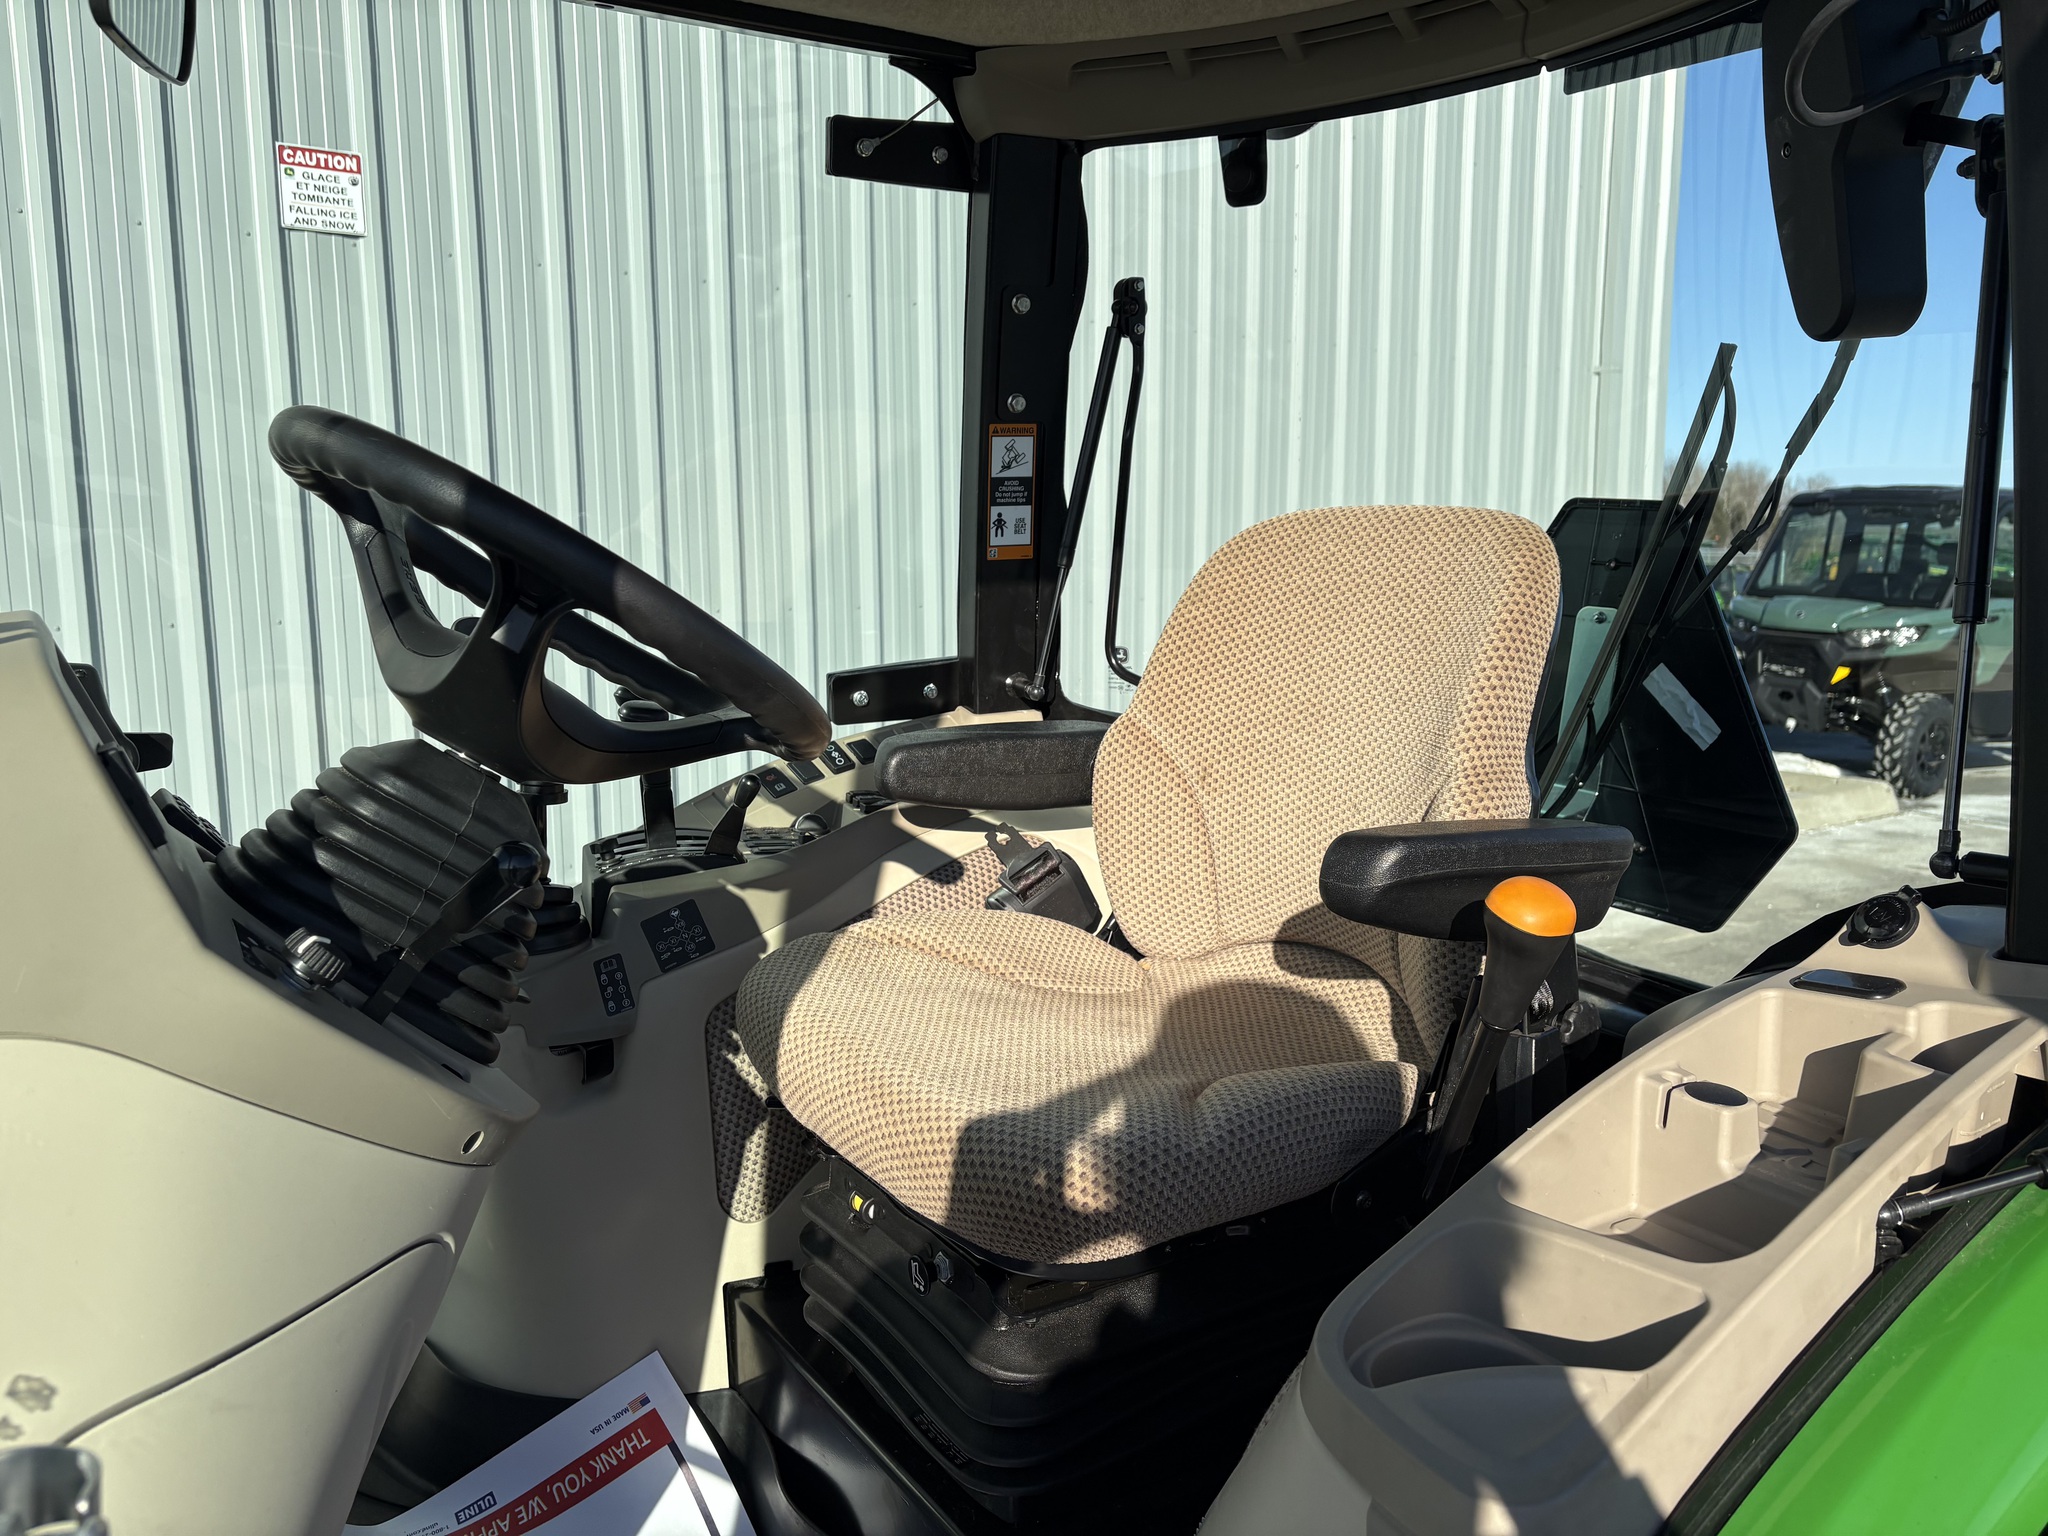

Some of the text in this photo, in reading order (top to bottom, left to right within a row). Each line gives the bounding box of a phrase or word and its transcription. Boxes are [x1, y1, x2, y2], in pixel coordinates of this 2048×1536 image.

[283, 148, 358, 173] CAUTION
[302, 171, 341, 185] GLACE
[296, 181, 348, 196] ET NEIGE
[291, 191, 354, 208] TOMBANTE
[289, 204, 358, 221] FALLING ICE
[293, 216, 355, 231] AND SNOW
[1000, 426, 1035, 434] WARNING
[1011, 491, 1024, 499] jump
[589, 1406, 630, 1435] MADE IN USA
[588, 1428, 652, 1478] THANK
[546, 1467, 593, 1504] YOU,
[457, 1494, 496, 1522] ULINE
[514, 1495, 549, 1525] WE
